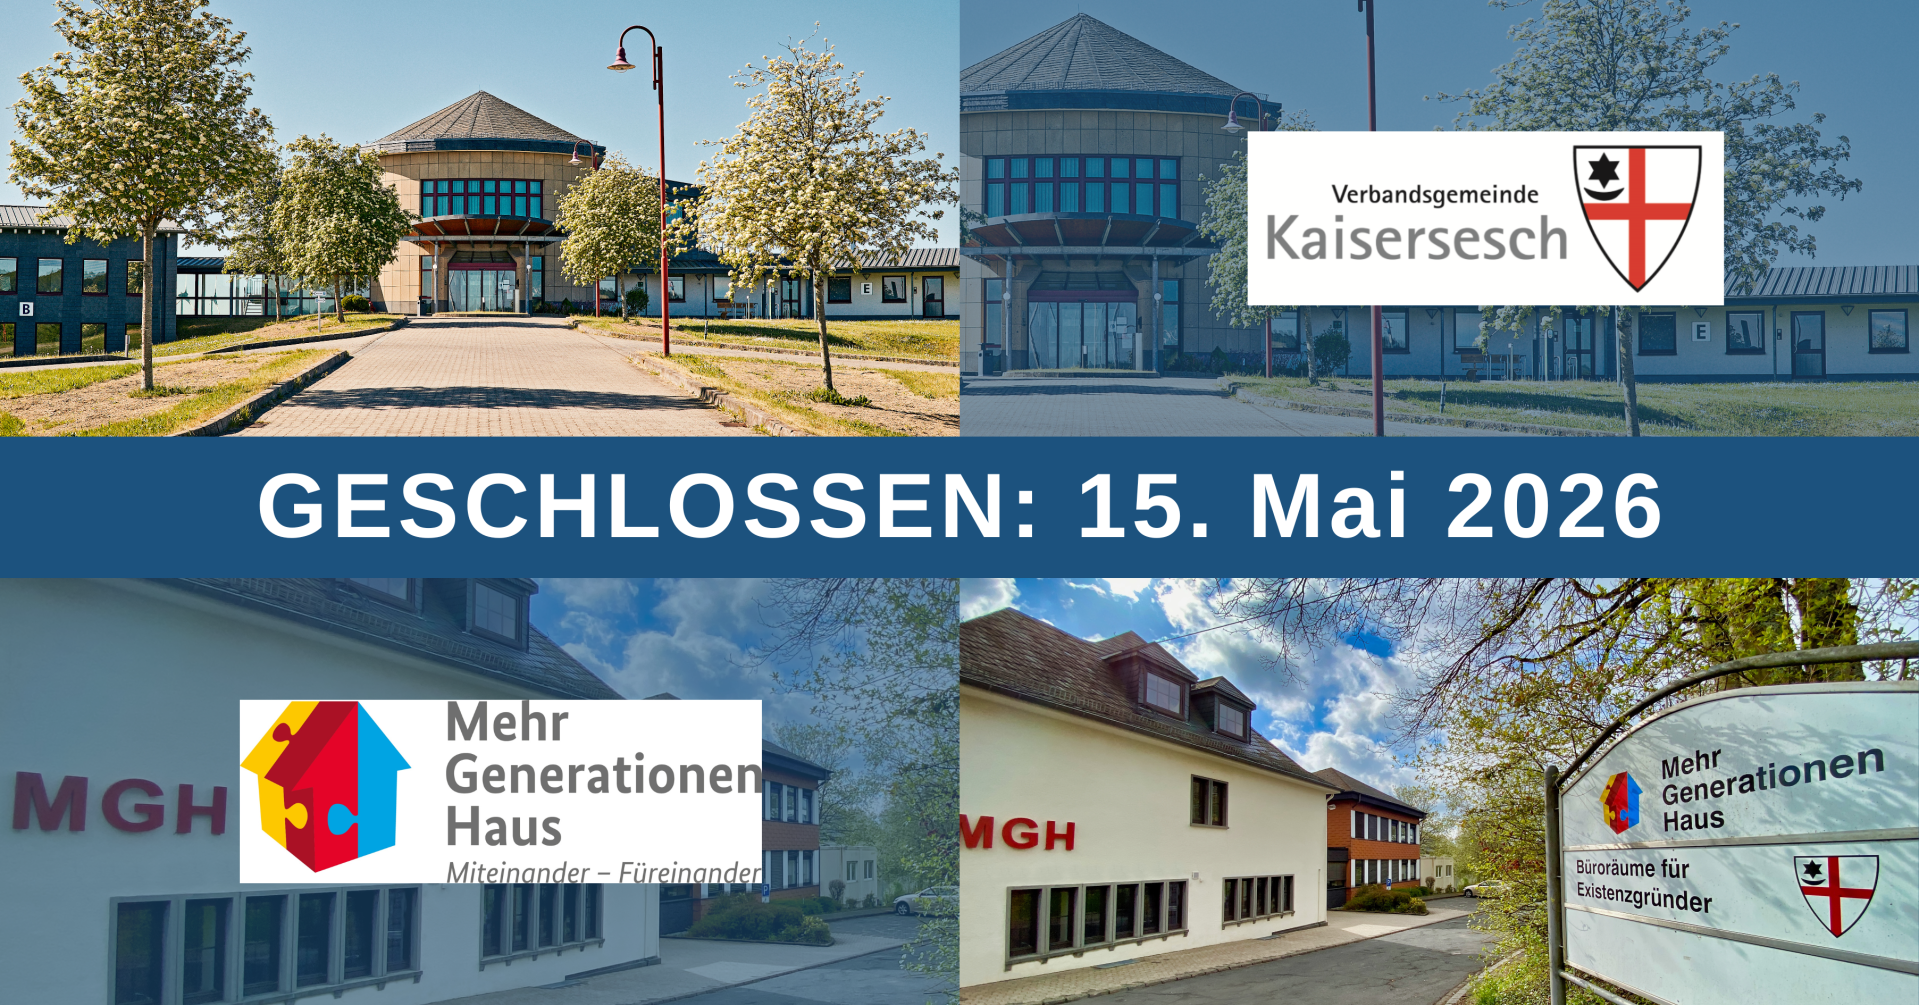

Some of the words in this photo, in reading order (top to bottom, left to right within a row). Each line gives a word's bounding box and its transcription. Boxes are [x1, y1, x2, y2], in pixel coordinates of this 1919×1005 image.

[863, 284, 870, 294] E
[22, 304, 31, 315] B
[1696, 324, 1706, 340] E
[1661, 748, 1722, 780] Mehr
[1662, 747, 1885, 806] Generationen
[12, 771, 228, 836] MGH
[959, 813, 1076, 851] MGH
[1663, 809, 1725, 832] Haus
[1576, 858, 1656, 878] Büroräume
[1660, 858, 1690, 879] für
[1577, 881, 1713, 914] Existenzgründer
